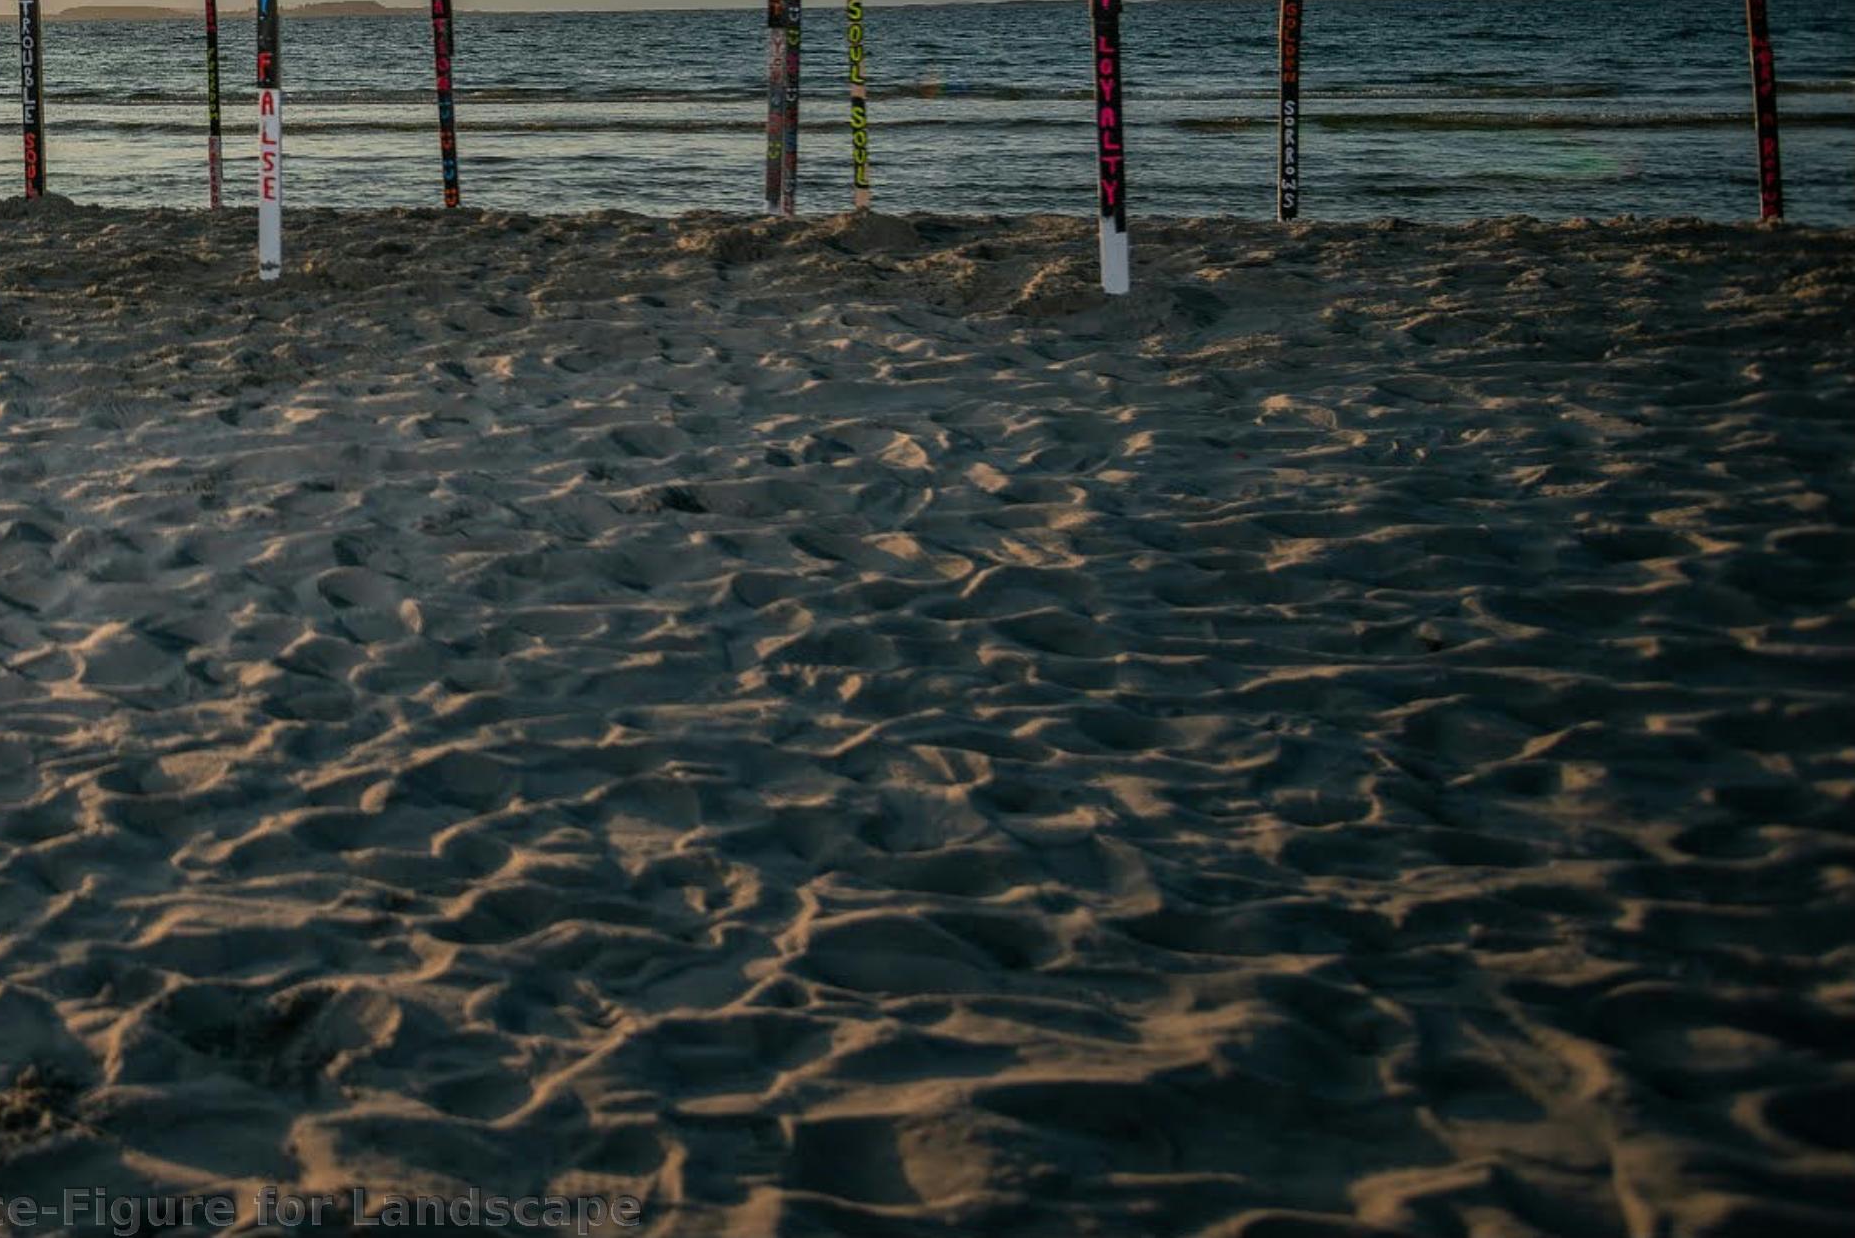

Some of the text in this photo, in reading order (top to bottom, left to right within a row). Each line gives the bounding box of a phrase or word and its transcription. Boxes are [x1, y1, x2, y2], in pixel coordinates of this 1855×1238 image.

[19, 0, 36, 125] TROUBLE
[1099, 35, 1123, 206] LOYALTY
[25, 133, 38, 197] SOUL
[258, 52, 277, 202] FALSE
[850, 106, 869, 186] SOUL
[1282, 100, 1296, 209] SORROWS
